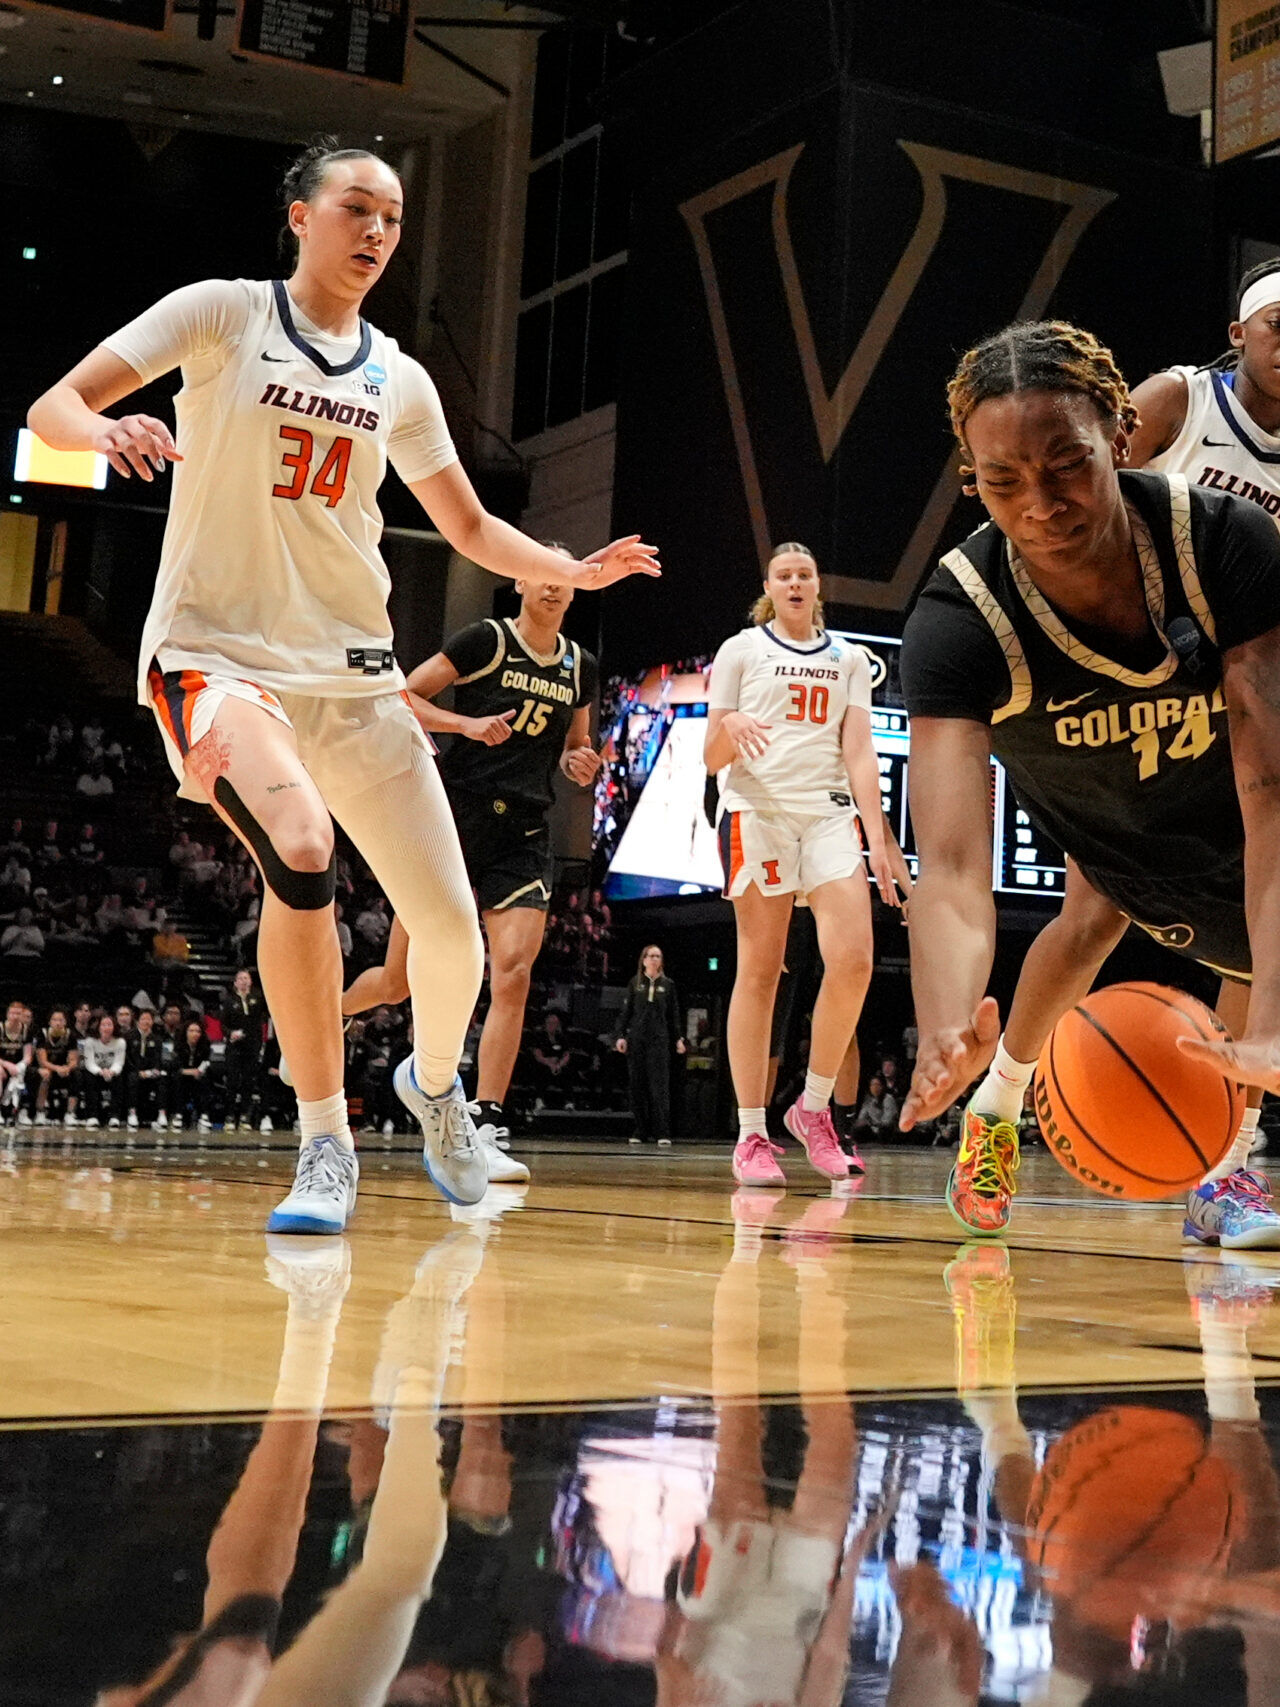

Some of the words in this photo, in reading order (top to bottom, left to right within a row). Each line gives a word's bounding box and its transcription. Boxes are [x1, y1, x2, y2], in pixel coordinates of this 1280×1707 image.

[259, 383, 380, 432] ILLINOIS
[272, 424, 353, 508] 34
[501, 669, 574, 706] COLORADO
[775, 666, 840, 681] ILLINOIS
[512, 699, 553, 737] 15
[786, 683, 829, 725] 30
[1131, 711, 1216, 781] 14
